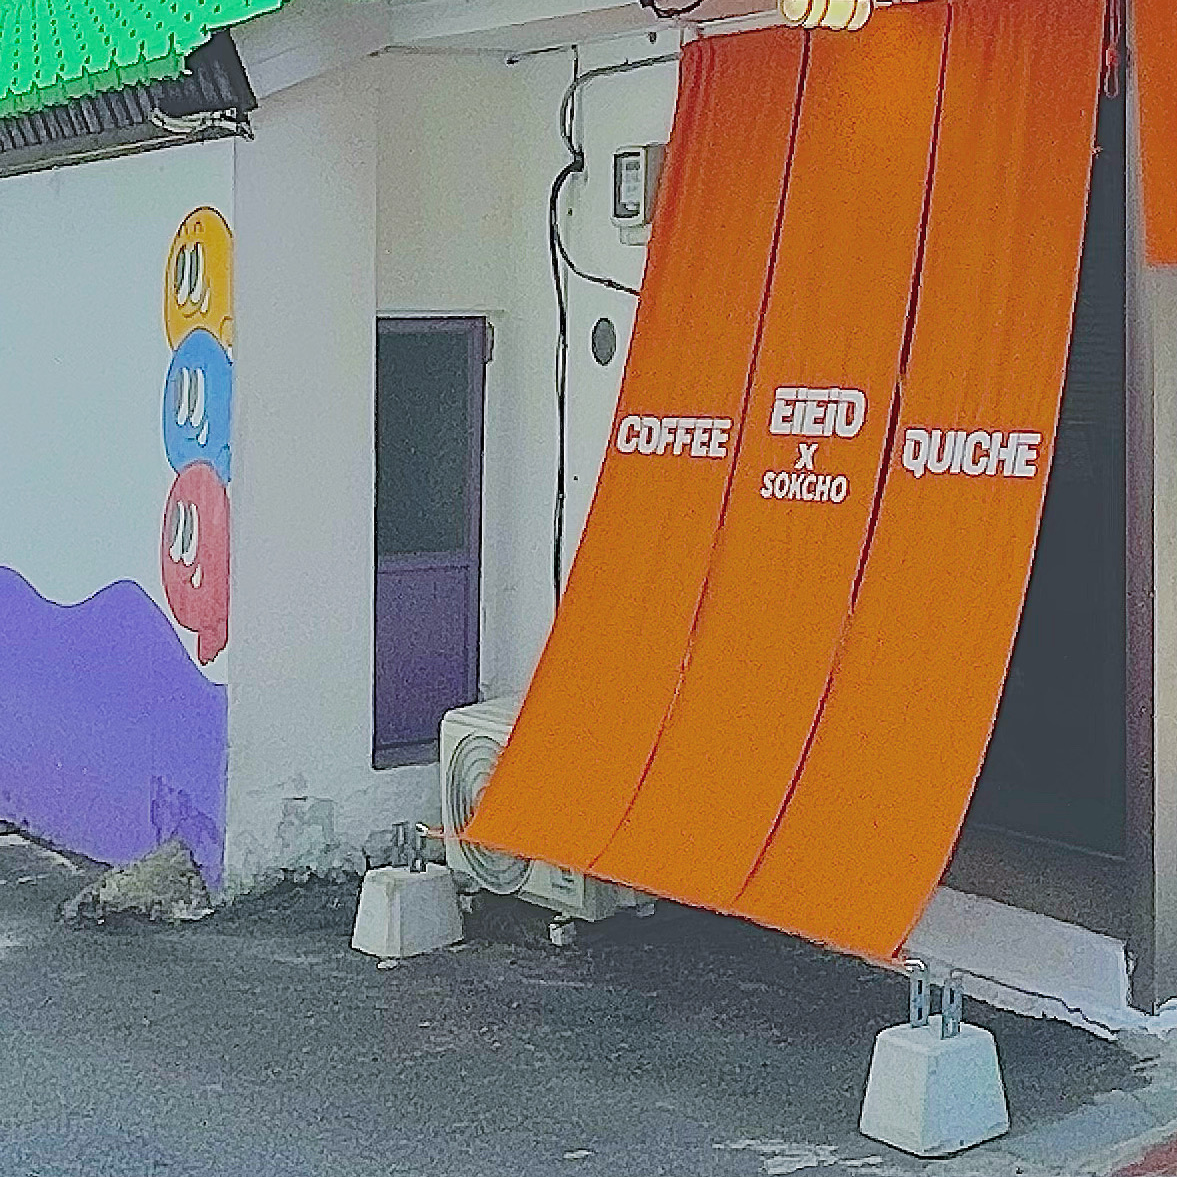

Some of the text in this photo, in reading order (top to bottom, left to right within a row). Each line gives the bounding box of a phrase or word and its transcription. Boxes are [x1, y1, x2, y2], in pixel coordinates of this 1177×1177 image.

[615, 415, 733, 458] COFFEE
[901, 428, 1043, 478] QUICHE
[760, 471, 850, 504] SOKCHO
